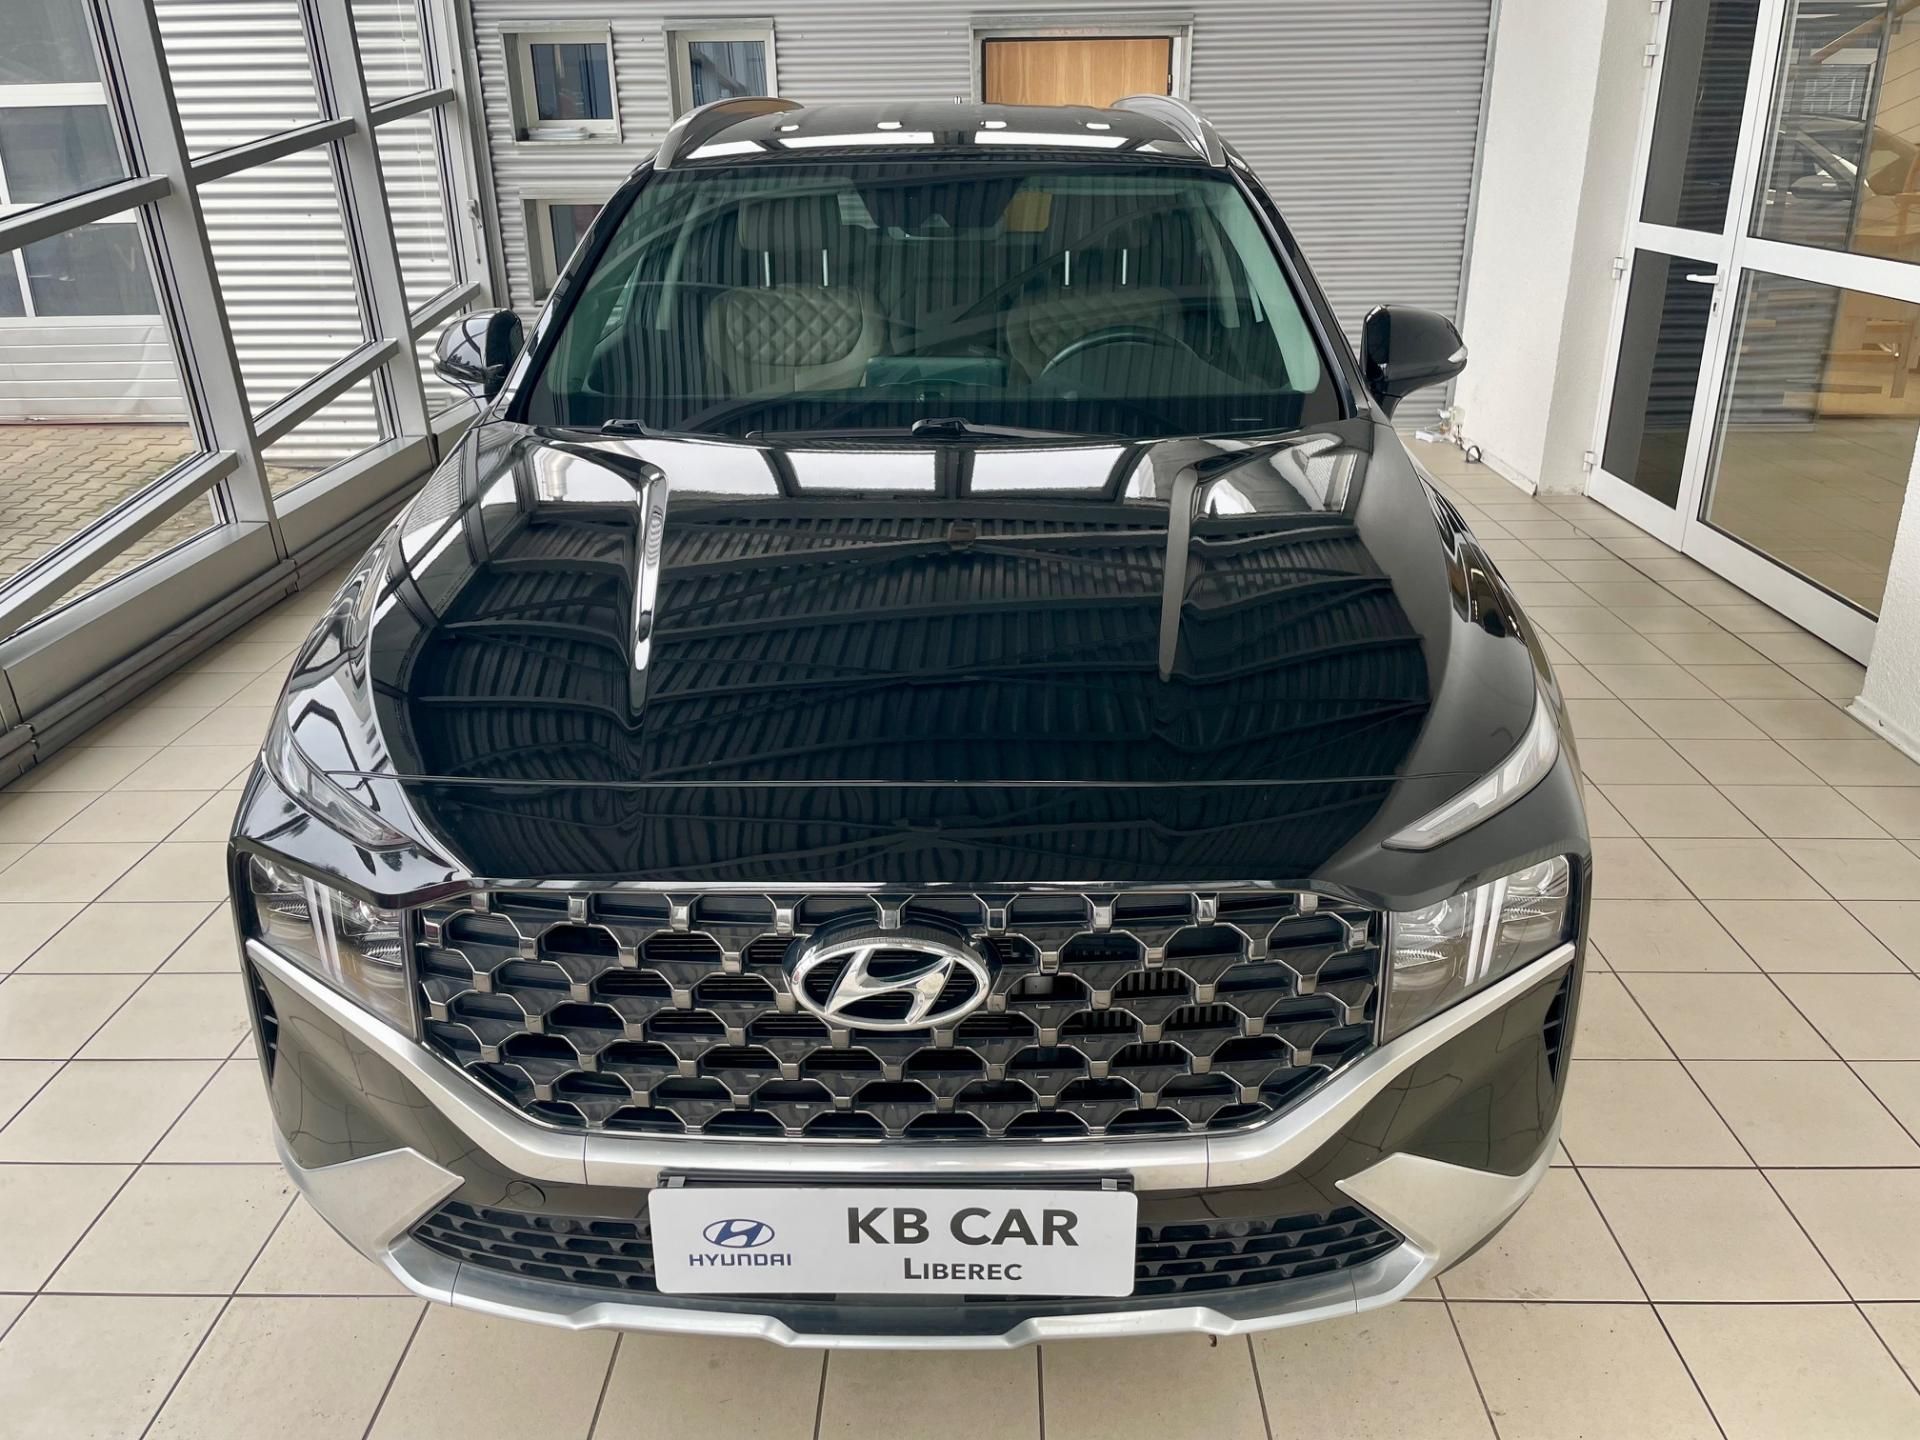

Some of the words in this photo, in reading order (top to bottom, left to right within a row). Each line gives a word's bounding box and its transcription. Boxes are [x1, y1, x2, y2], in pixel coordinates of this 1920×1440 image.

[847, 1207, 930, 1245] KB
[949, 1207, 1079, 1247] CAR
[689, 1252, 792, 1267] HYUNDAI
[903, 1257, 1023, 1281] LIBEREC
